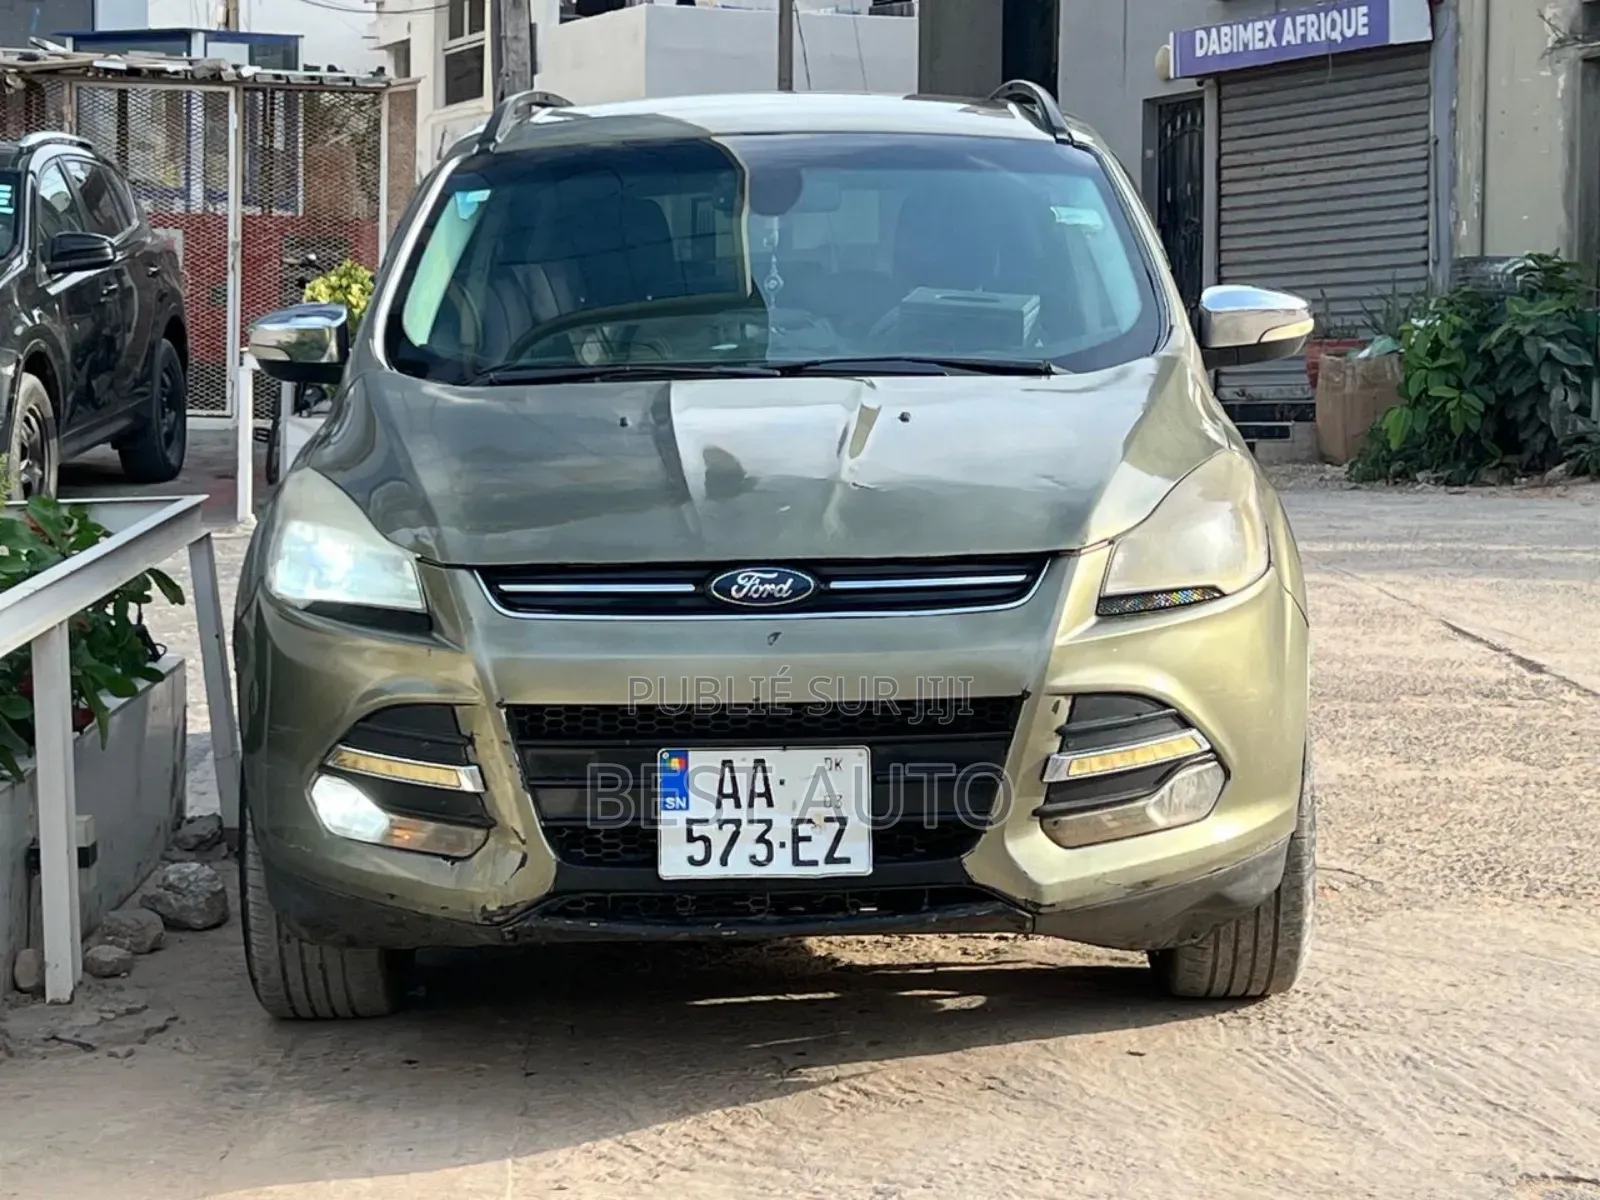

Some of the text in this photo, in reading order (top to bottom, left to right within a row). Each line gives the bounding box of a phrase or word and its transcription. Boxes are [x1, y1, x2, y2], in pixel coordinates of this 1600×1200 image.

[1195, 5, 1369, 58] DABIMEX AFRIQUE
[731, 572, 794, 599] Ford
[665, 797, 687, 810] SN
